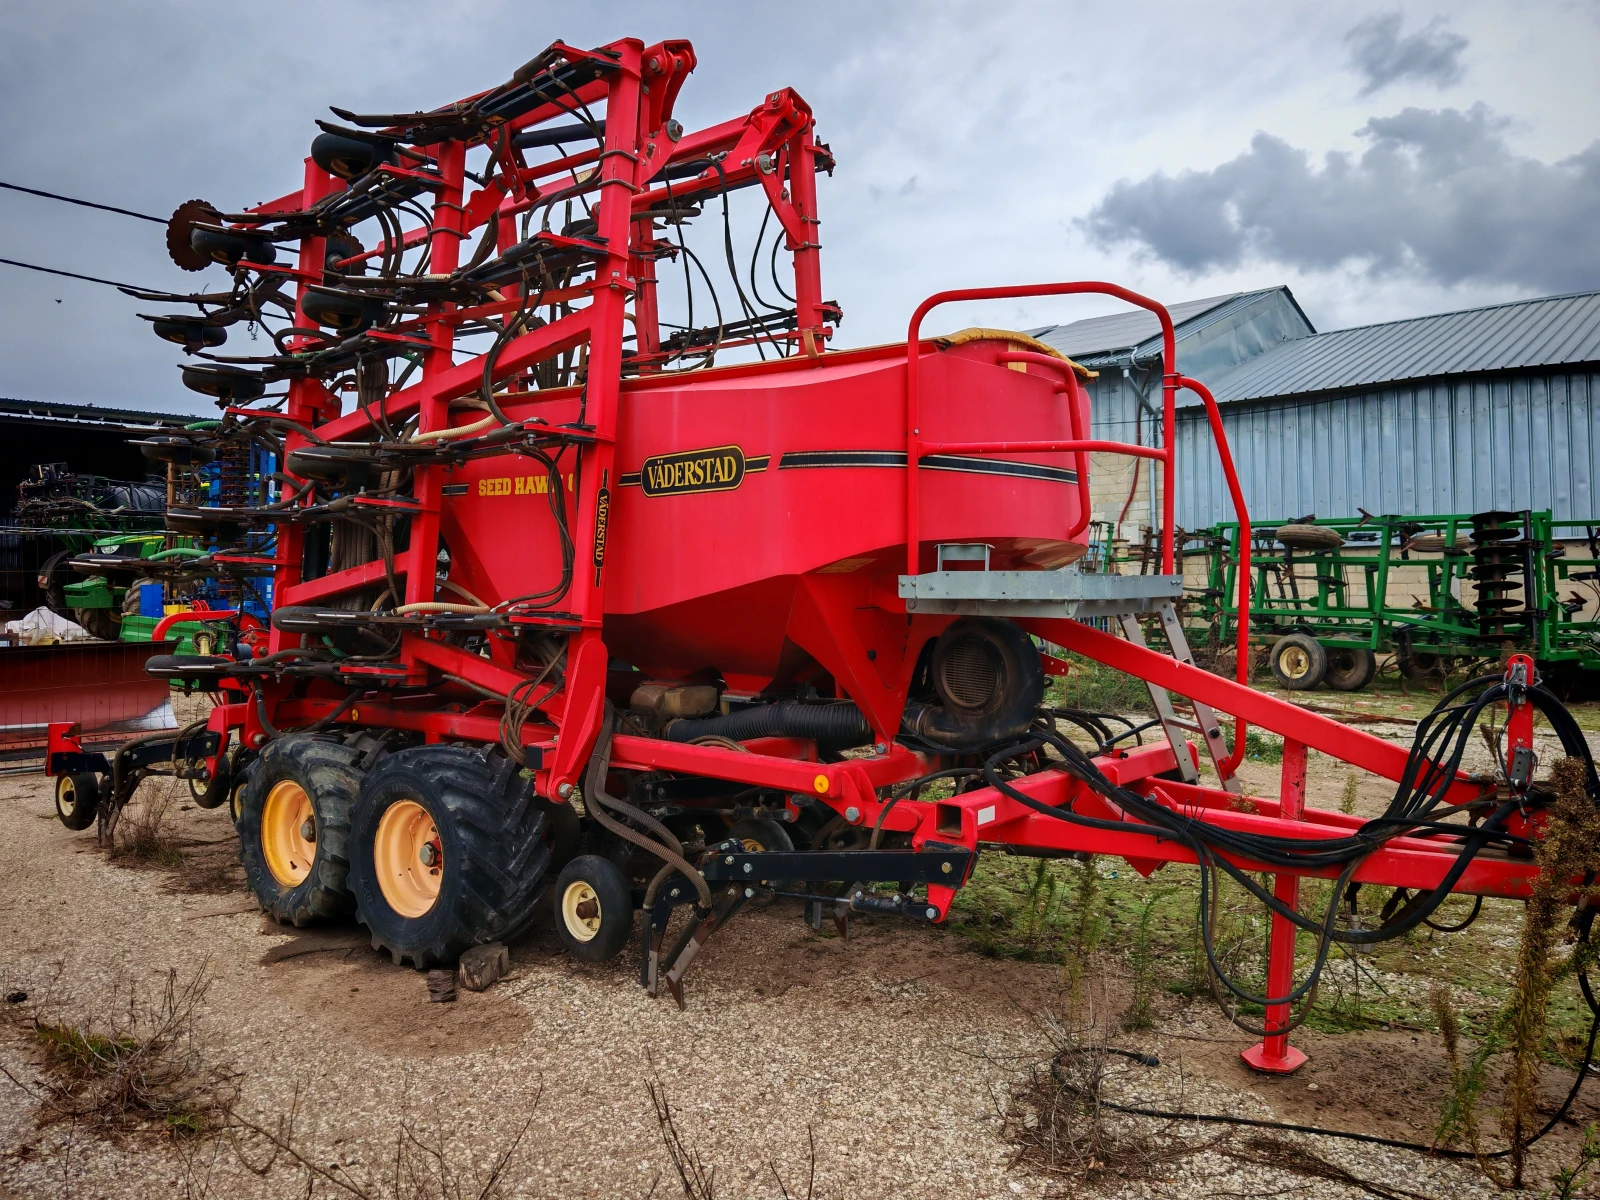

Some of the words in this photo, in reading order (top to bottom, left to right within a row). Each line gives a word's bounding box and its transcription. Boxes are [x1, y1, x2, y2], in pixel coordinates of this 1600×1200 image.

[478, 478, 512, 496] SEED
[514, 474, 563, 495] HAW
[647, 456, 737, 489] VÄDERSTAD
[595, 494, 609, 561] VÄDERSTAD
